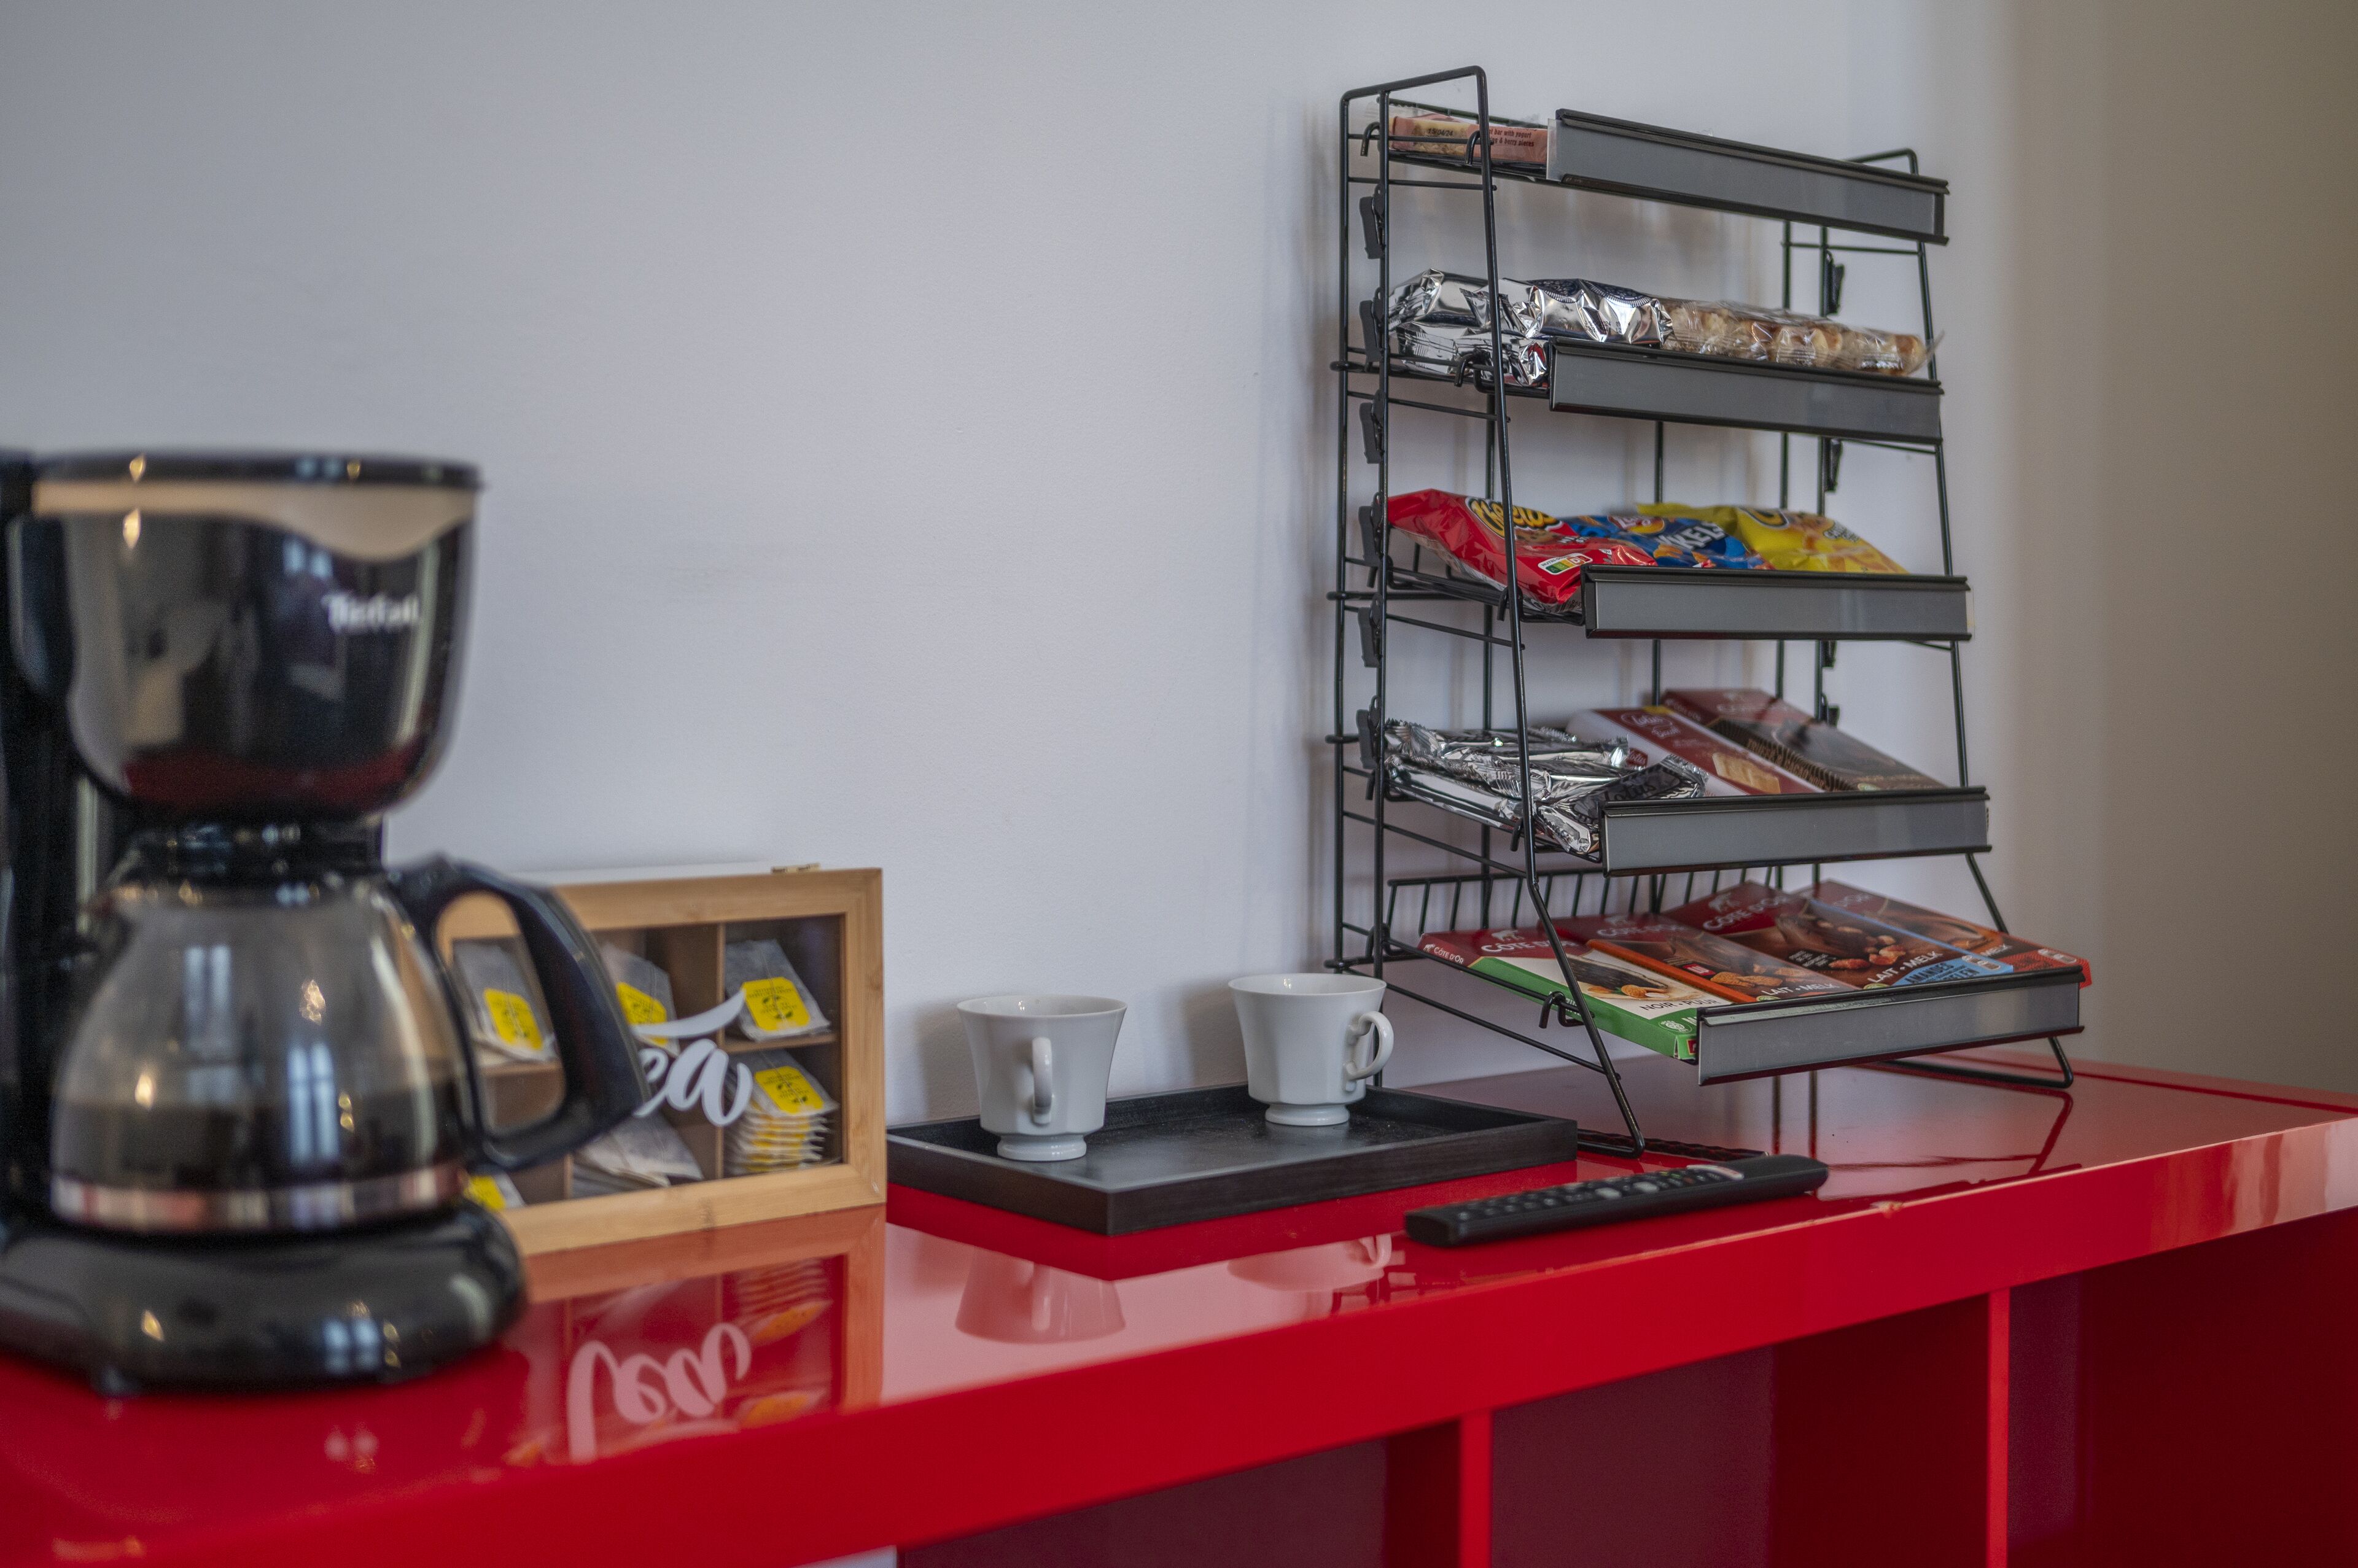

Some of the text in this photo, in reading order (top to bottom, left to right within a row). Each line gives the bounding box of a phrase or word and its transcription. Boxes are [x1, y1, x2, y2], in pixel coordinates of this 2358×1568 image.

[1434, 945, 1465, 965] CÔTE D'OR
[1867, 950, 1944, 984] LAIT MELK
[1761, 987, 1790, 996] LAIT
[1640, 998, 1720, 1011] NOIR PUUR
